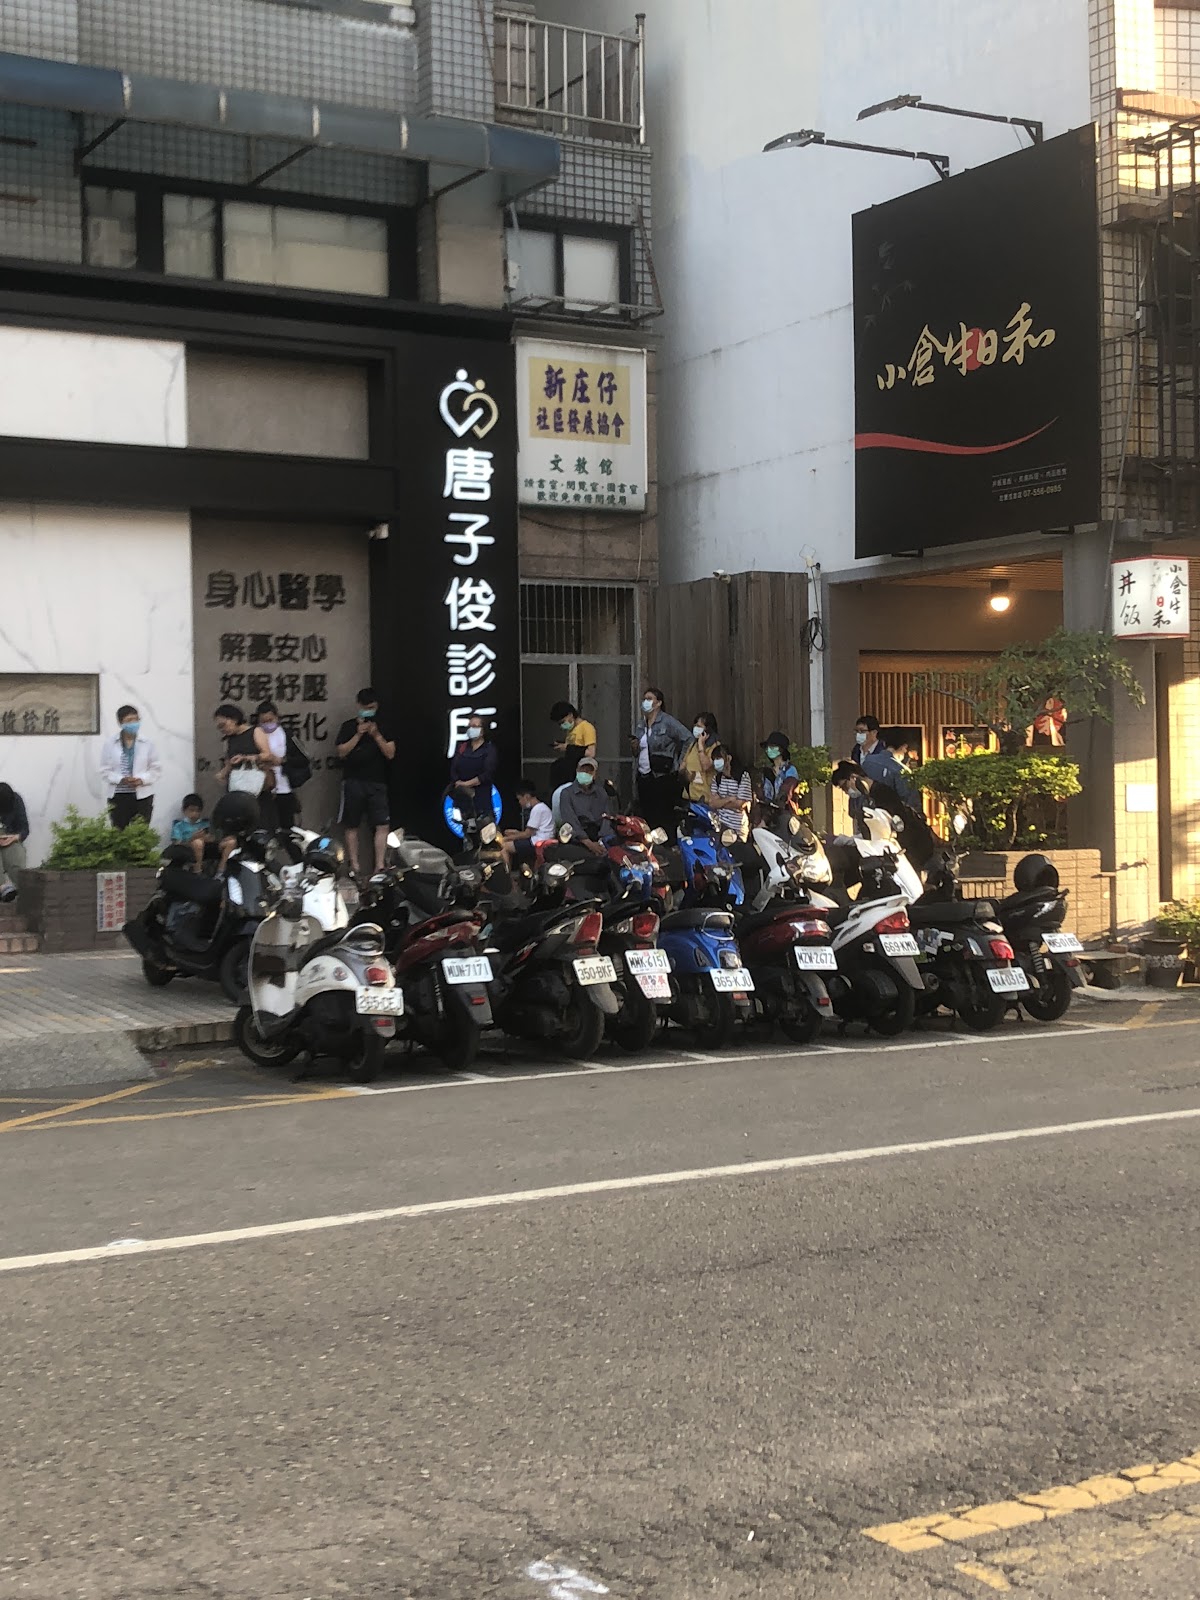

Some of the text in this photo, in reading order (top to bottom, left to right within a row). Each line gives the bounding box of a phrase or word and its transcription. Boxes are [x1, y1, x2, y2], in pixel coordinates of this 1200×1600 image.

[543, 364, 618, 405] 新庄仔
[536, 406, 625, 438] 社區發展協會
[550, 454, 613, 476] 文教館
[205, 570, 346, 613] 身心醫學
[218, 632, 328, 663] 解憂安心
[218, 672, 328, 702] 好眠紓壓
[578, 964, 613, 981] 350-BKF
[713, 976, 752, 988] 365-KJU
